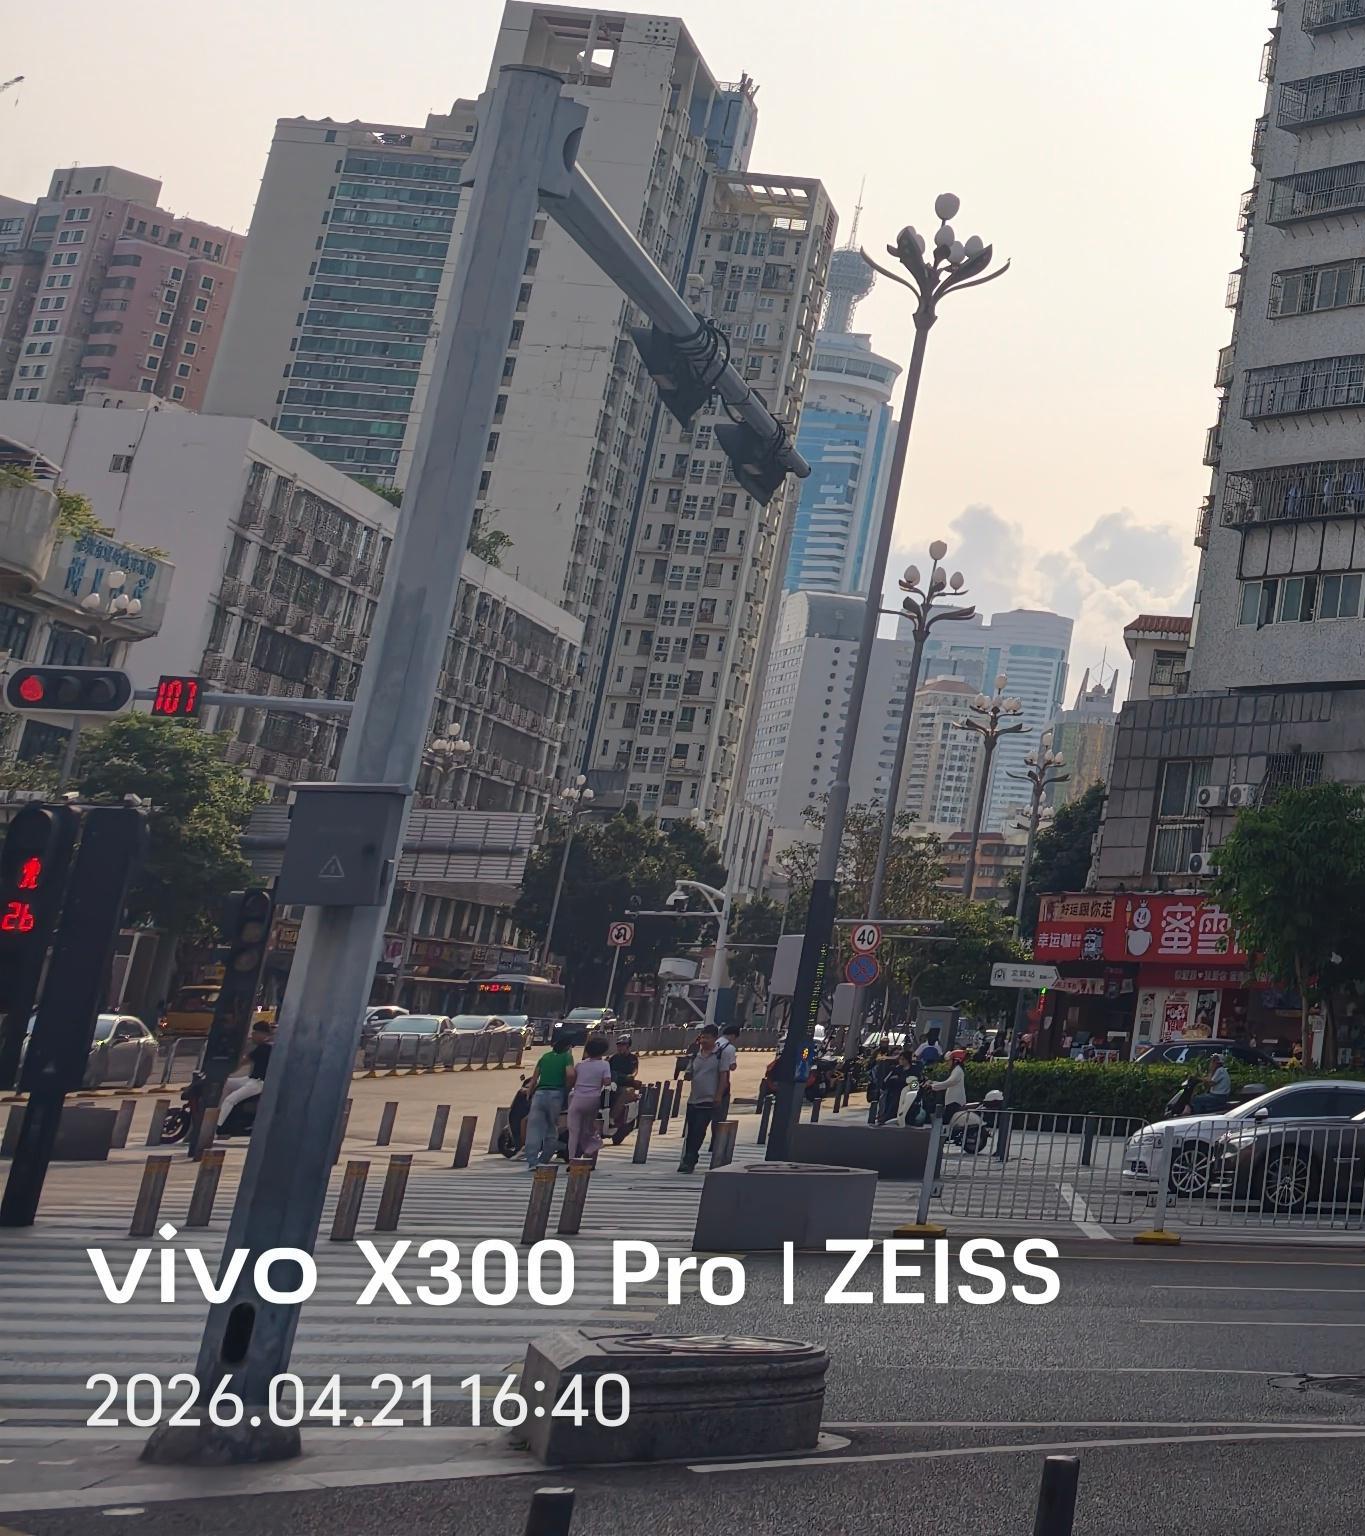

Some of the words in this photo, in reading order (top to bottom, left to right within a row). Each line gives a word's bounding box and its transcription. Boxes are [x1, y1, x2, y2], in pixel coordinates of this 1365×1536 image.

[154, 678, 198, 716] 107
[1, 902, 36, 933] 26
[857, 929, 876, 946] 40
[1037, 931, 1073, 949] 幸运咖
